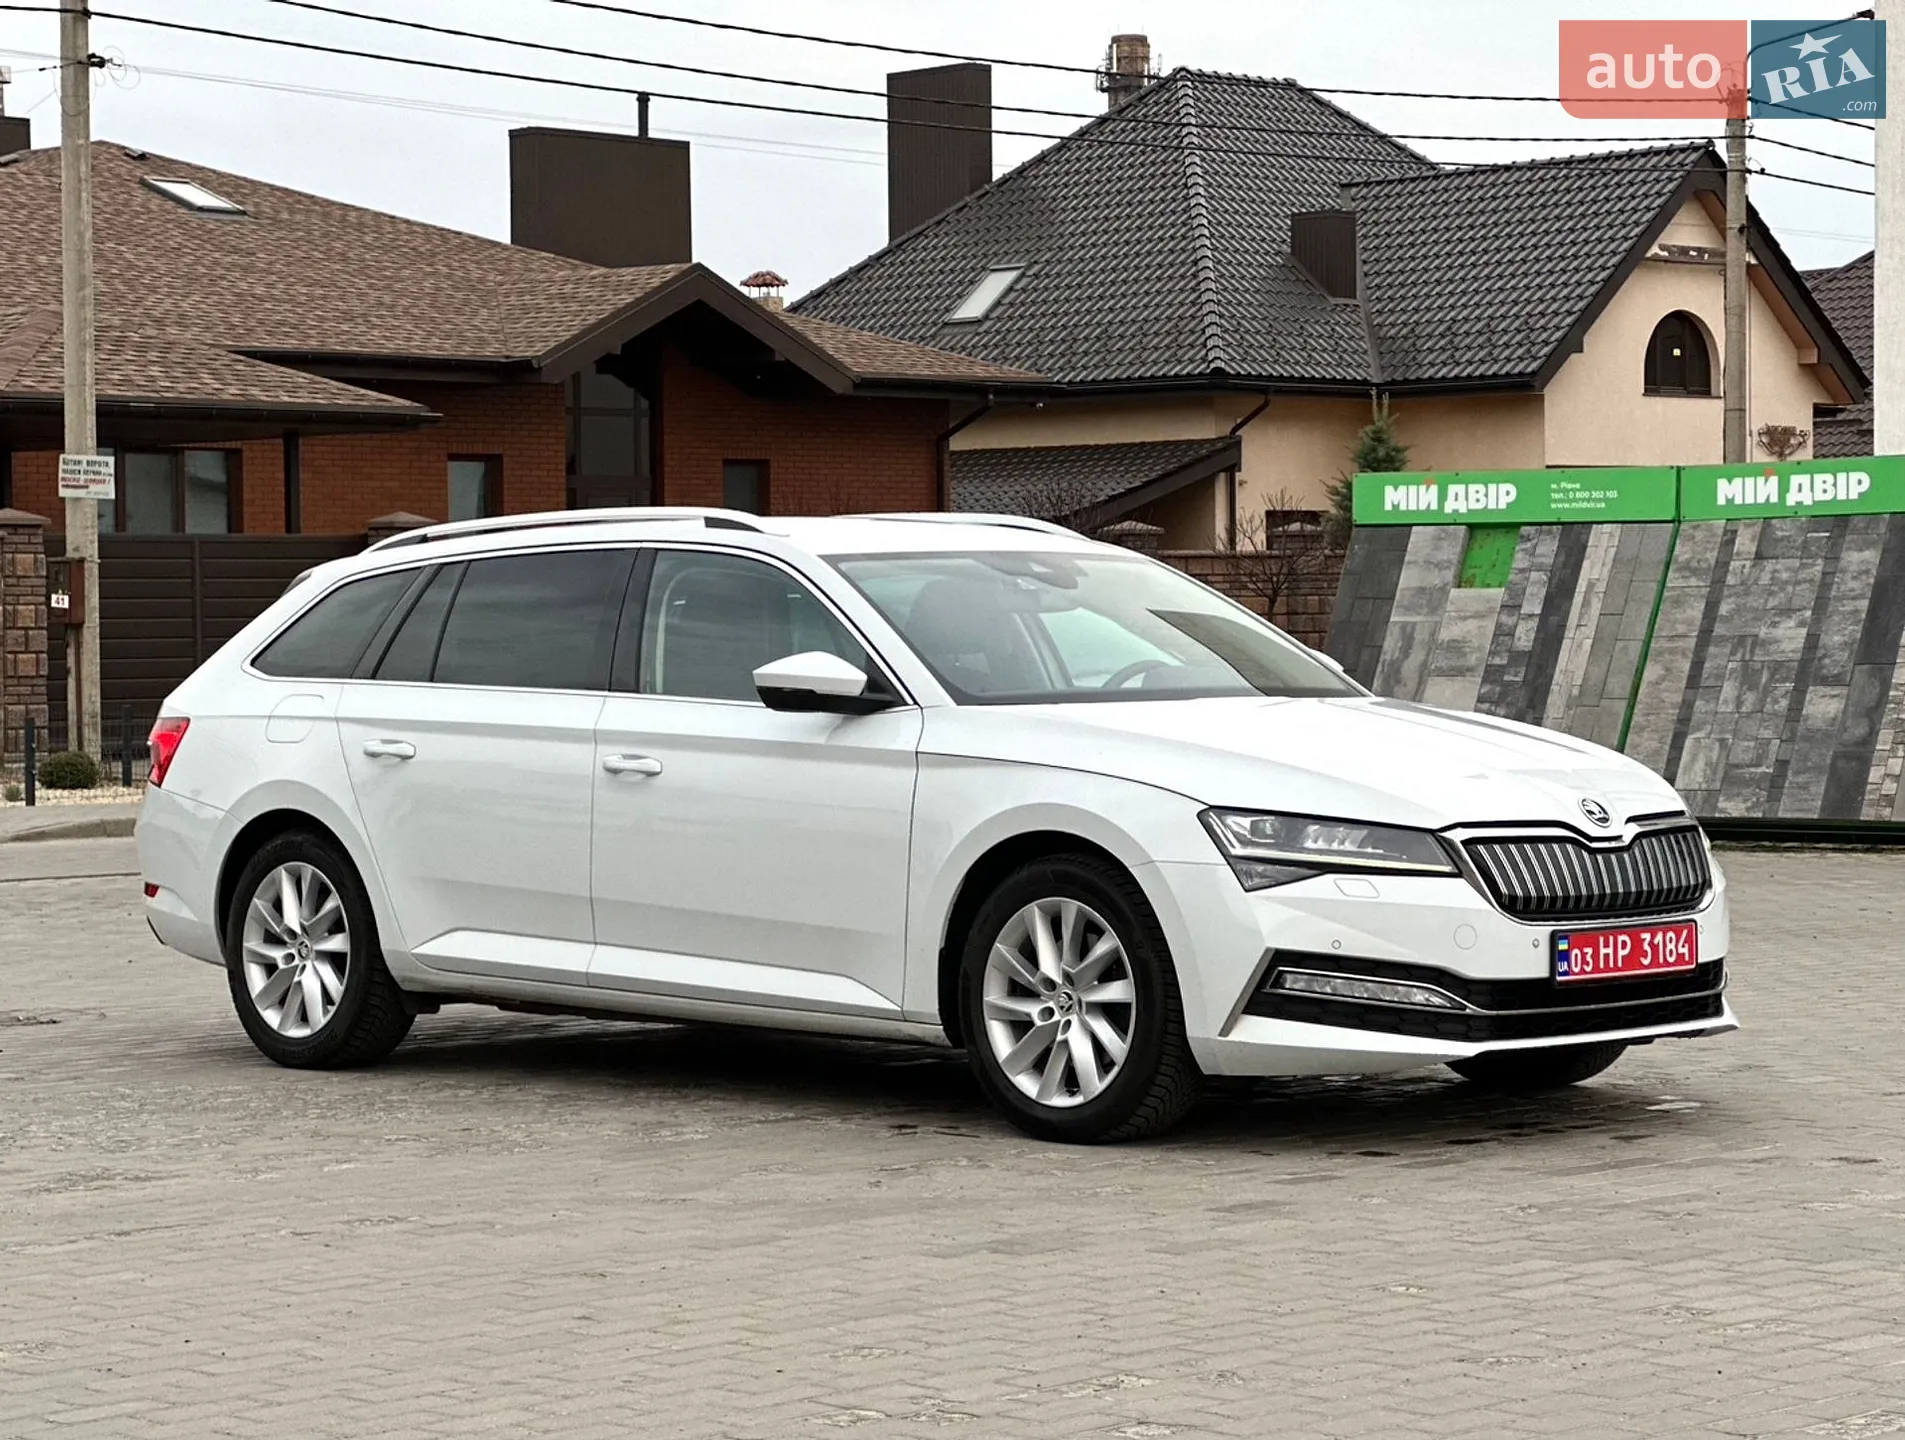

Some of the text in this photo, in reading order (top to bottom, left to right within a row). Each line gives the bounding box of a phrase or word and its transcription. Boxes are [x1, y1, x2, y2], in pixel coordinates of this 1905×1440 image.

[1384, 478, 1517, 513] МІЙ ДВІР
[1717, 468, 1870, 506] МІЙ ДВІР
[55, 596, 65, 605] 41
[1558, 961, 1569, 972] UA
[1571, 929, 1689, 973] 03 HP 3184
